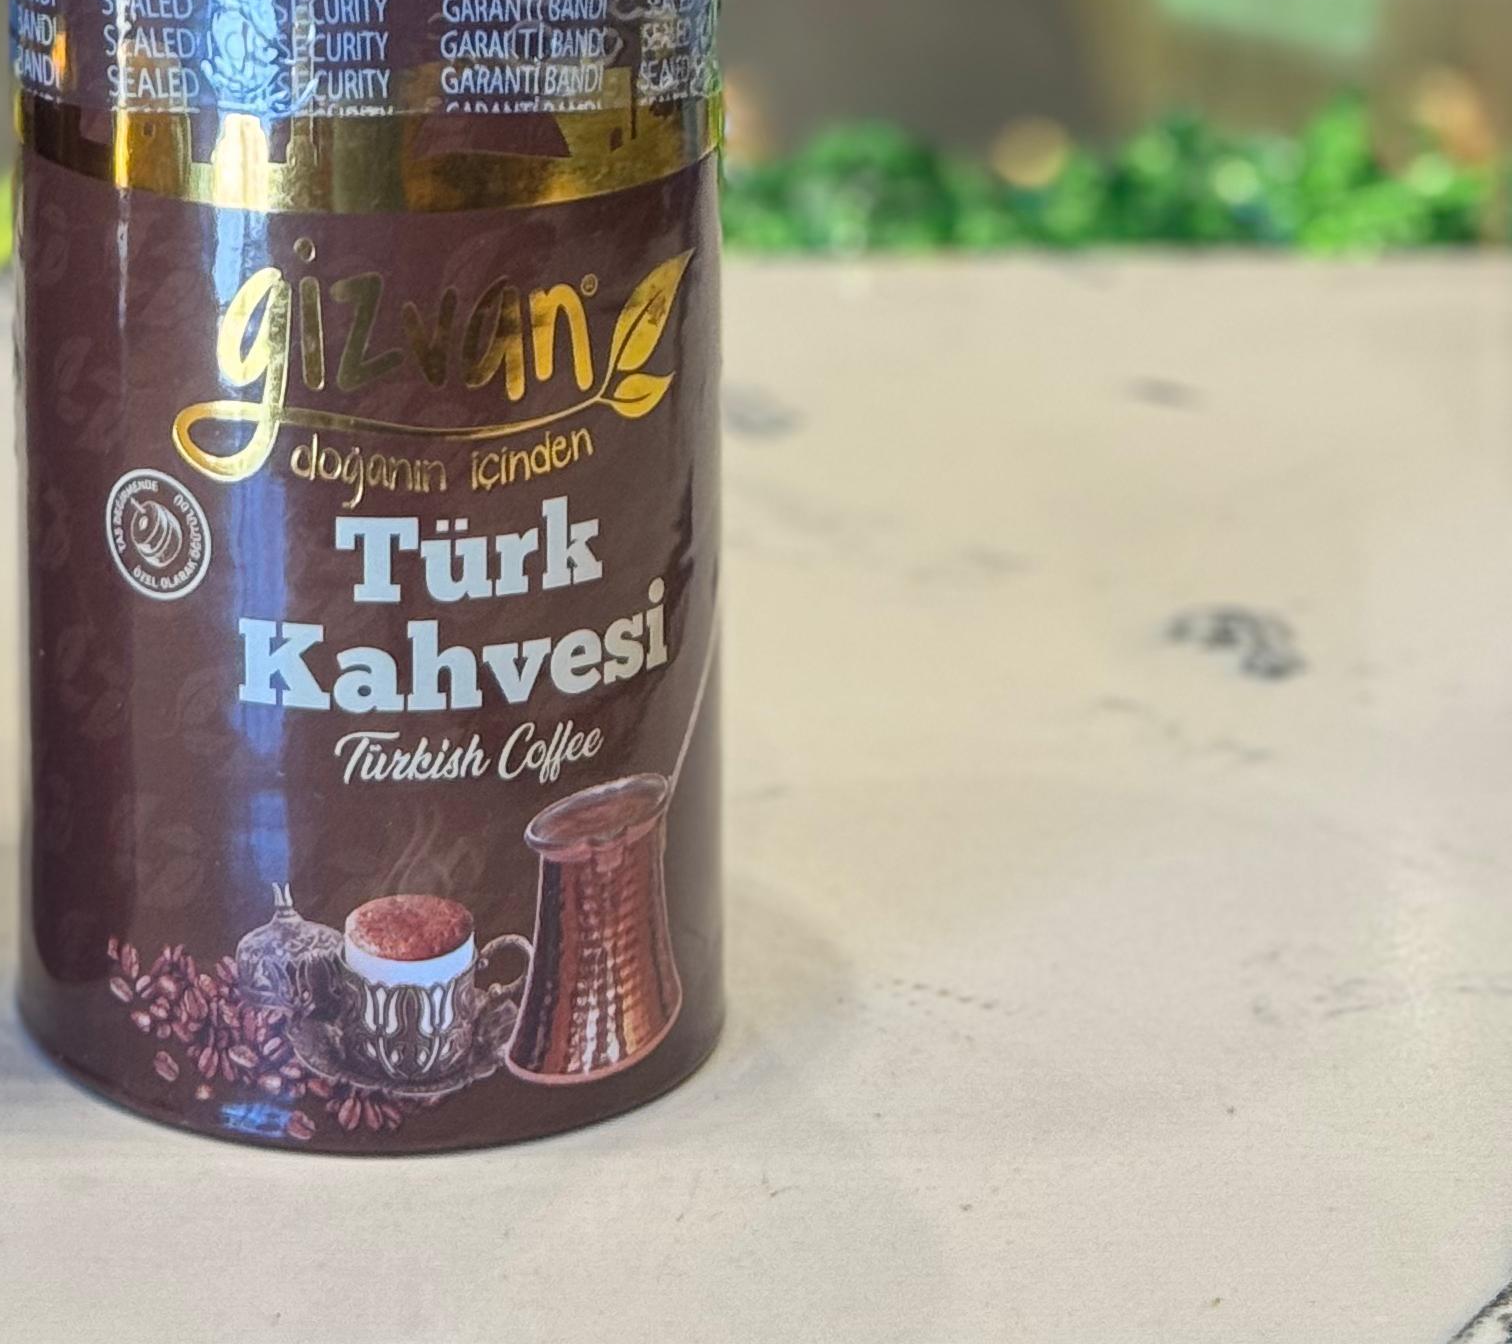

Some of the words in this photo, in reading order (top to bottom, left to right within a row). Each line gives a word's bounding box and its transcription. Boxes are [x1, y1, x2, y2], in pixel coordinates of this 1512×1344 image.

[544, 62, 605, 95] BANDI
[172, 238, 595, 482] gizvan
[471, 427, 594, 491] içinden
[335, 495, 603, 602] Türk
[238, 577, 669, 712] Kahvesi
[498, 719, 605, 783] Coffee
